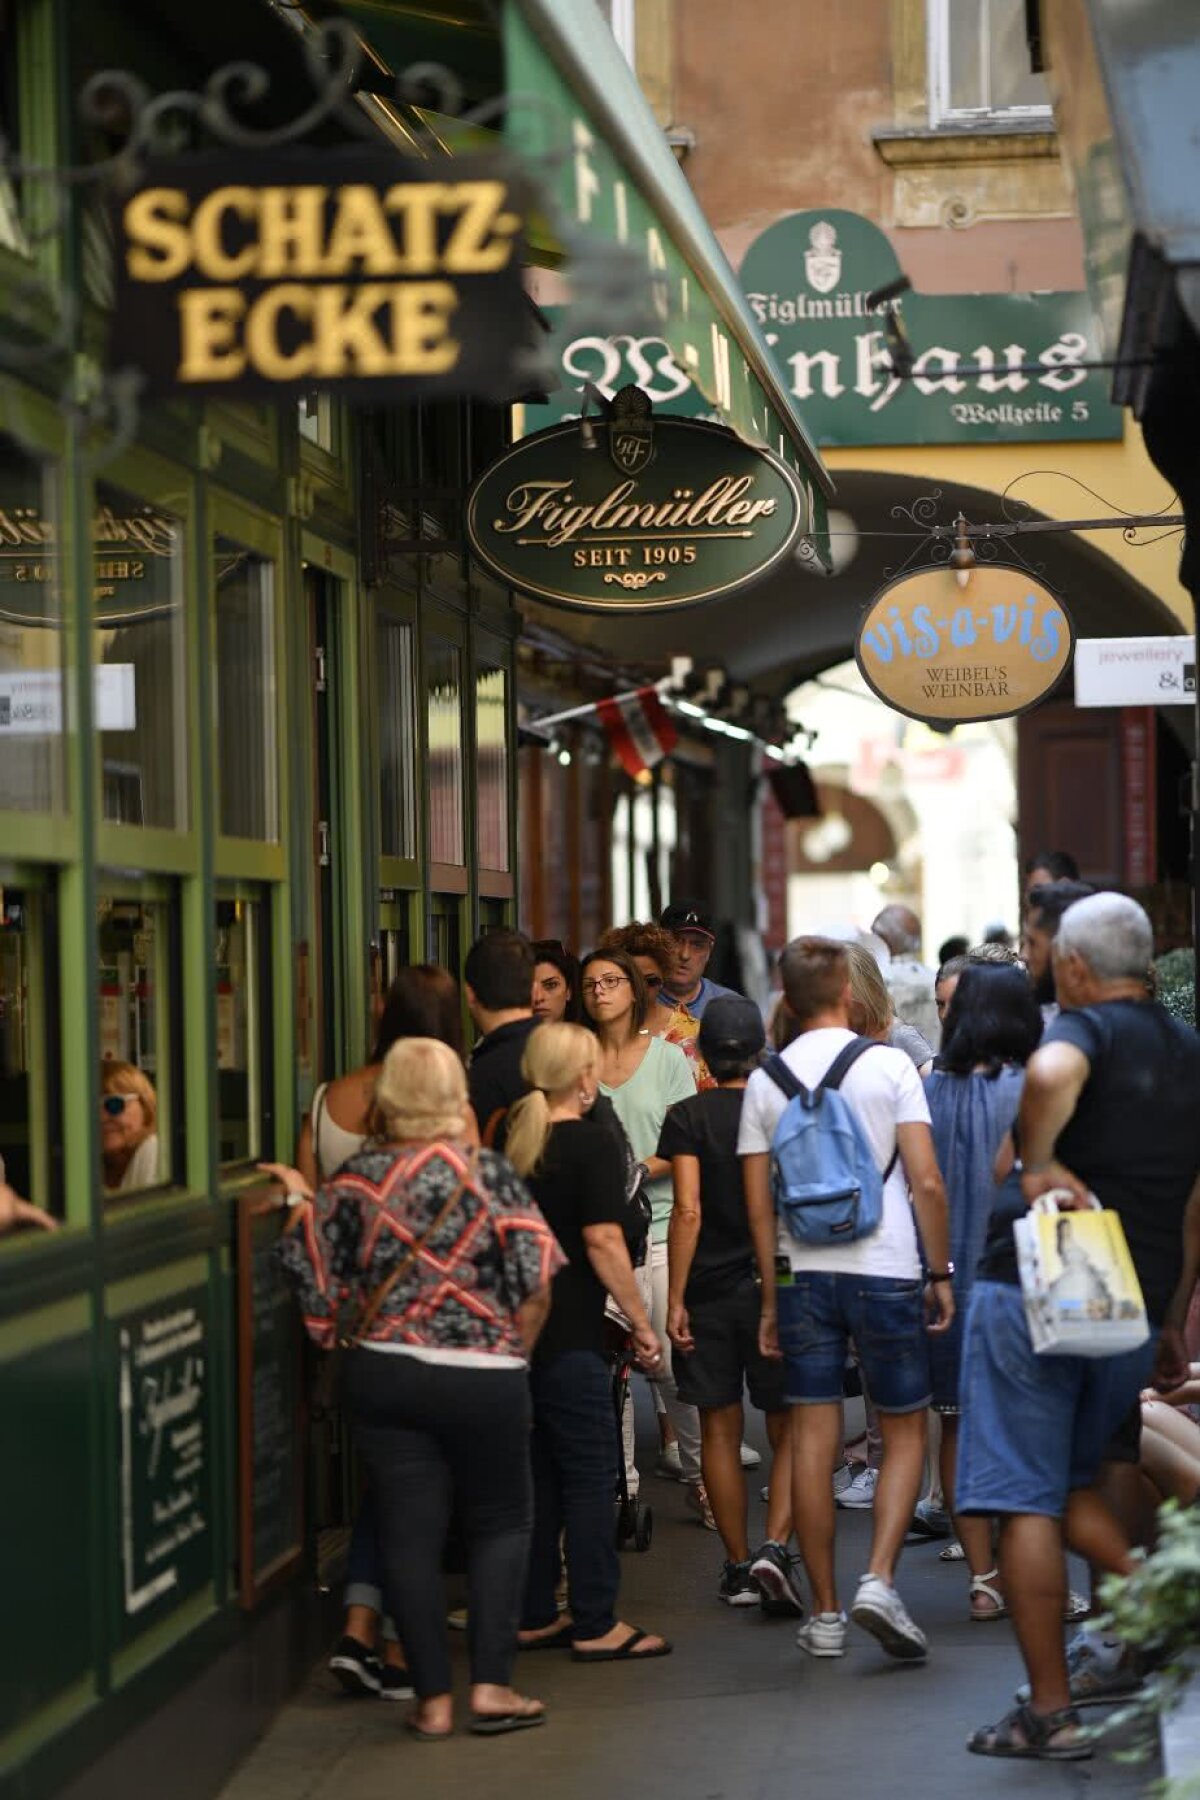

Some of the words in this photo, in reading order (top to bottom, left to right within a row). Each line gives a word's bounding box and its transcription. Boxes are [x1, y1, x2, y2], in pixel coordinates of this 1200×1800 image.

[747, 292, 903, 323] Figlmüller
[178, 282, 460, 383] ECKE
[951, 403, 1063, 426] Wollzeile
[1071, 401, 1089, 422] 5
[493, 475, 776, 548] Figlmüller
[573, 547, 630, 567] SEIT
[643, 545, 697, 565] 1905
[864, 593, 1066, 664] vis-a-vis
[925, 665, 1008, 683] WEIBEL'S
[921, 681, 1009, 699] WEINBAR
